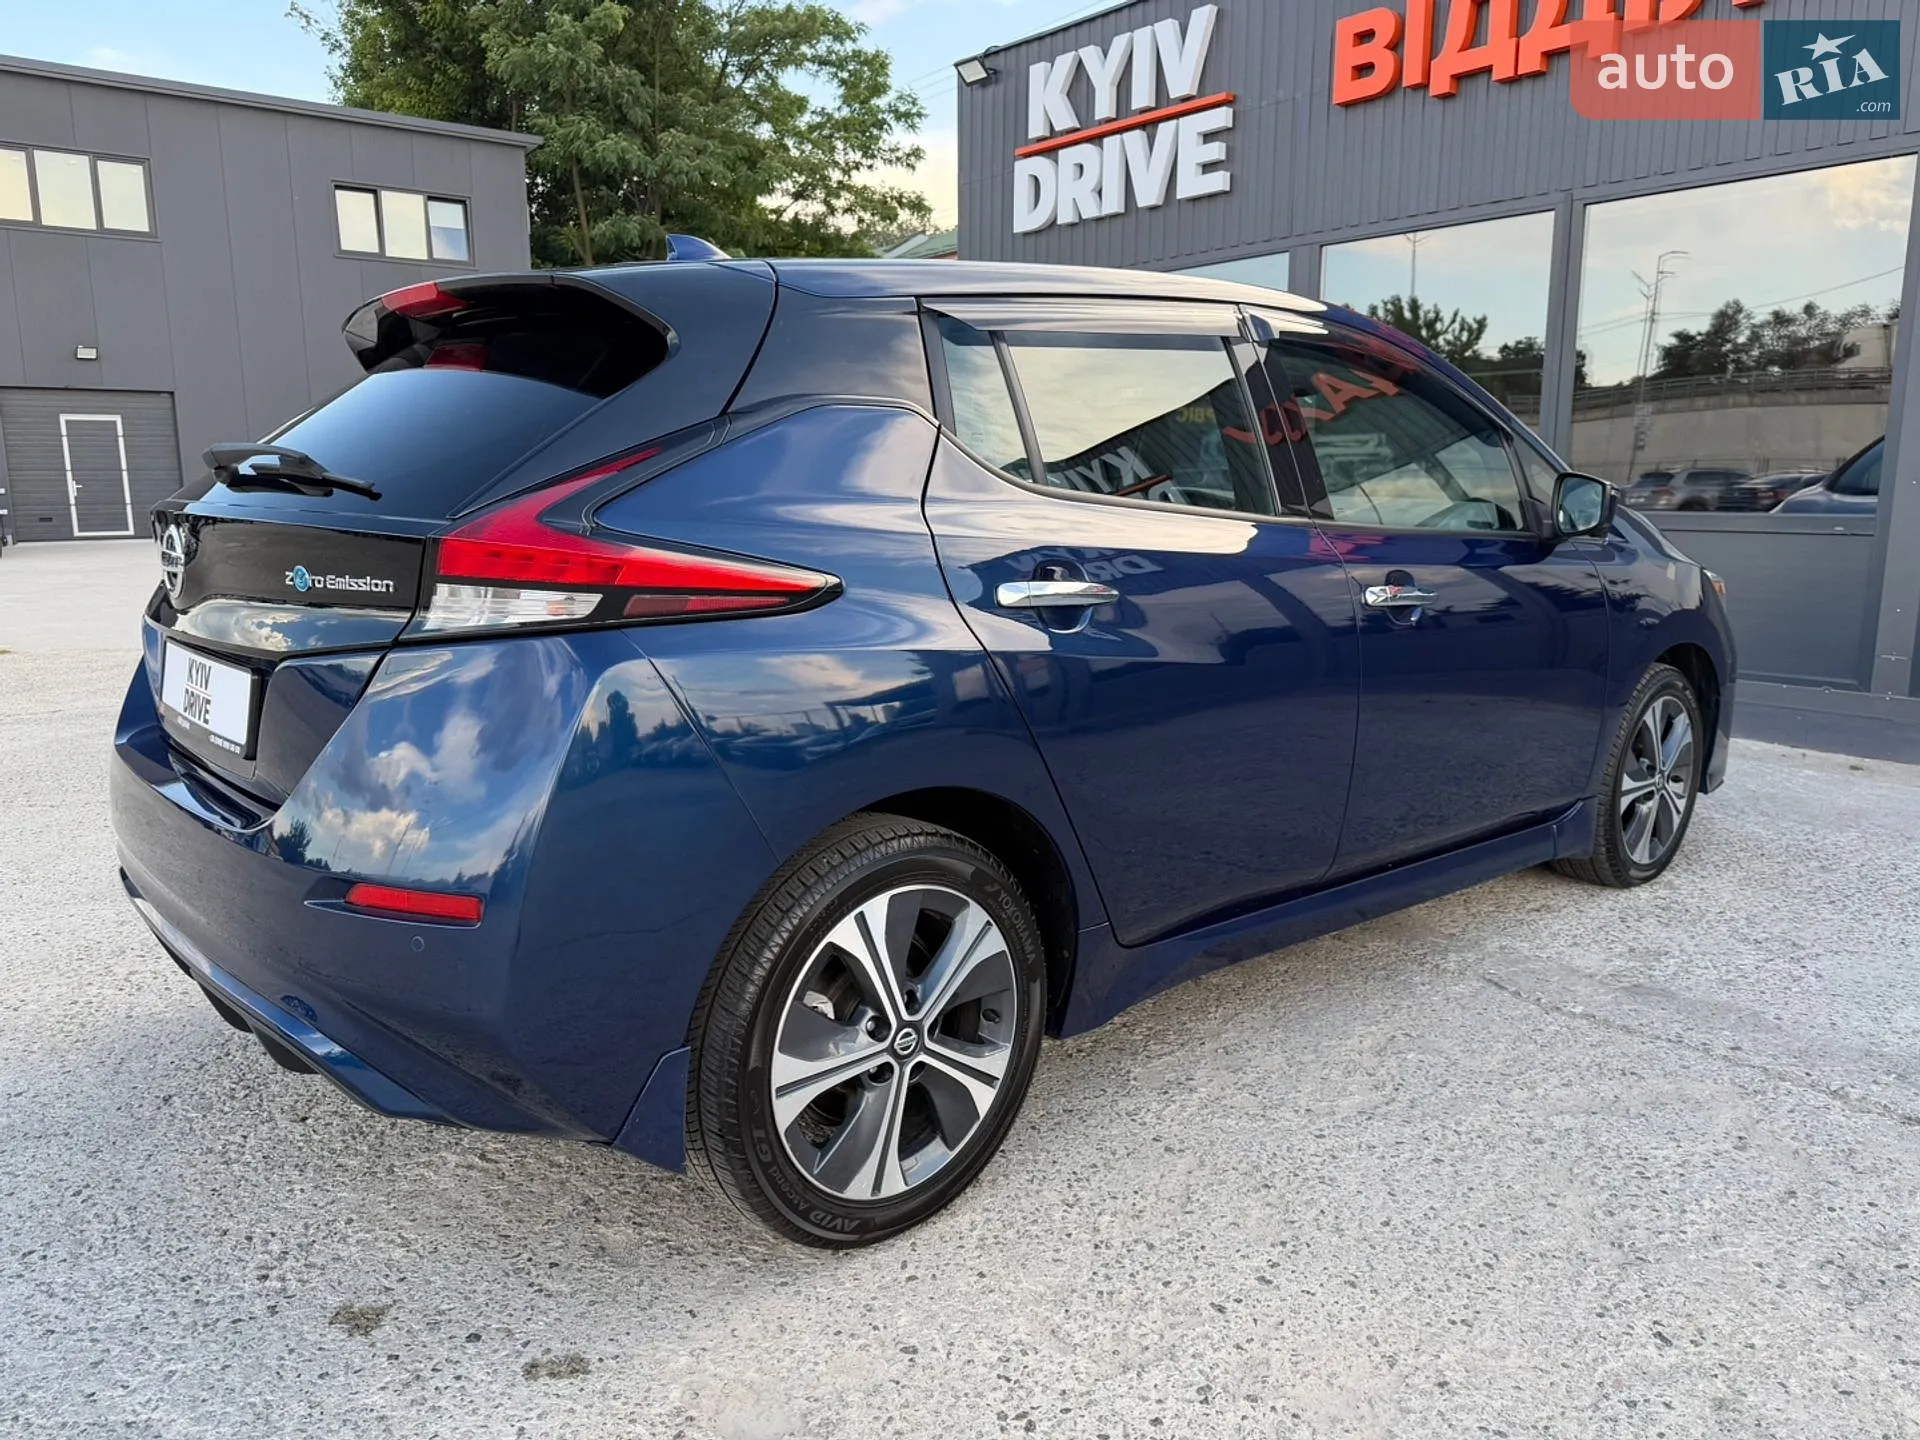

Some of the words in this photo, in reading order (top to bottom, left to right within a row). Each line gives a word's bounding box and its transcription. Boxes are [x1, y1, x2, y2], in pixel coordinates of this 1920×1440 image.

[1028, 4, 1219, 139] KYIV
[1333, 0, 1764, 106] ВІДД
[1013, 106, 1233, 234] DRIVE
[326, 575, 394, 593] Emission
[183, 687, 211, 725] DRIVE
[187, 657, 211, 690] KYIV
[998, 889, 1036, 965] YOKOHAMA
